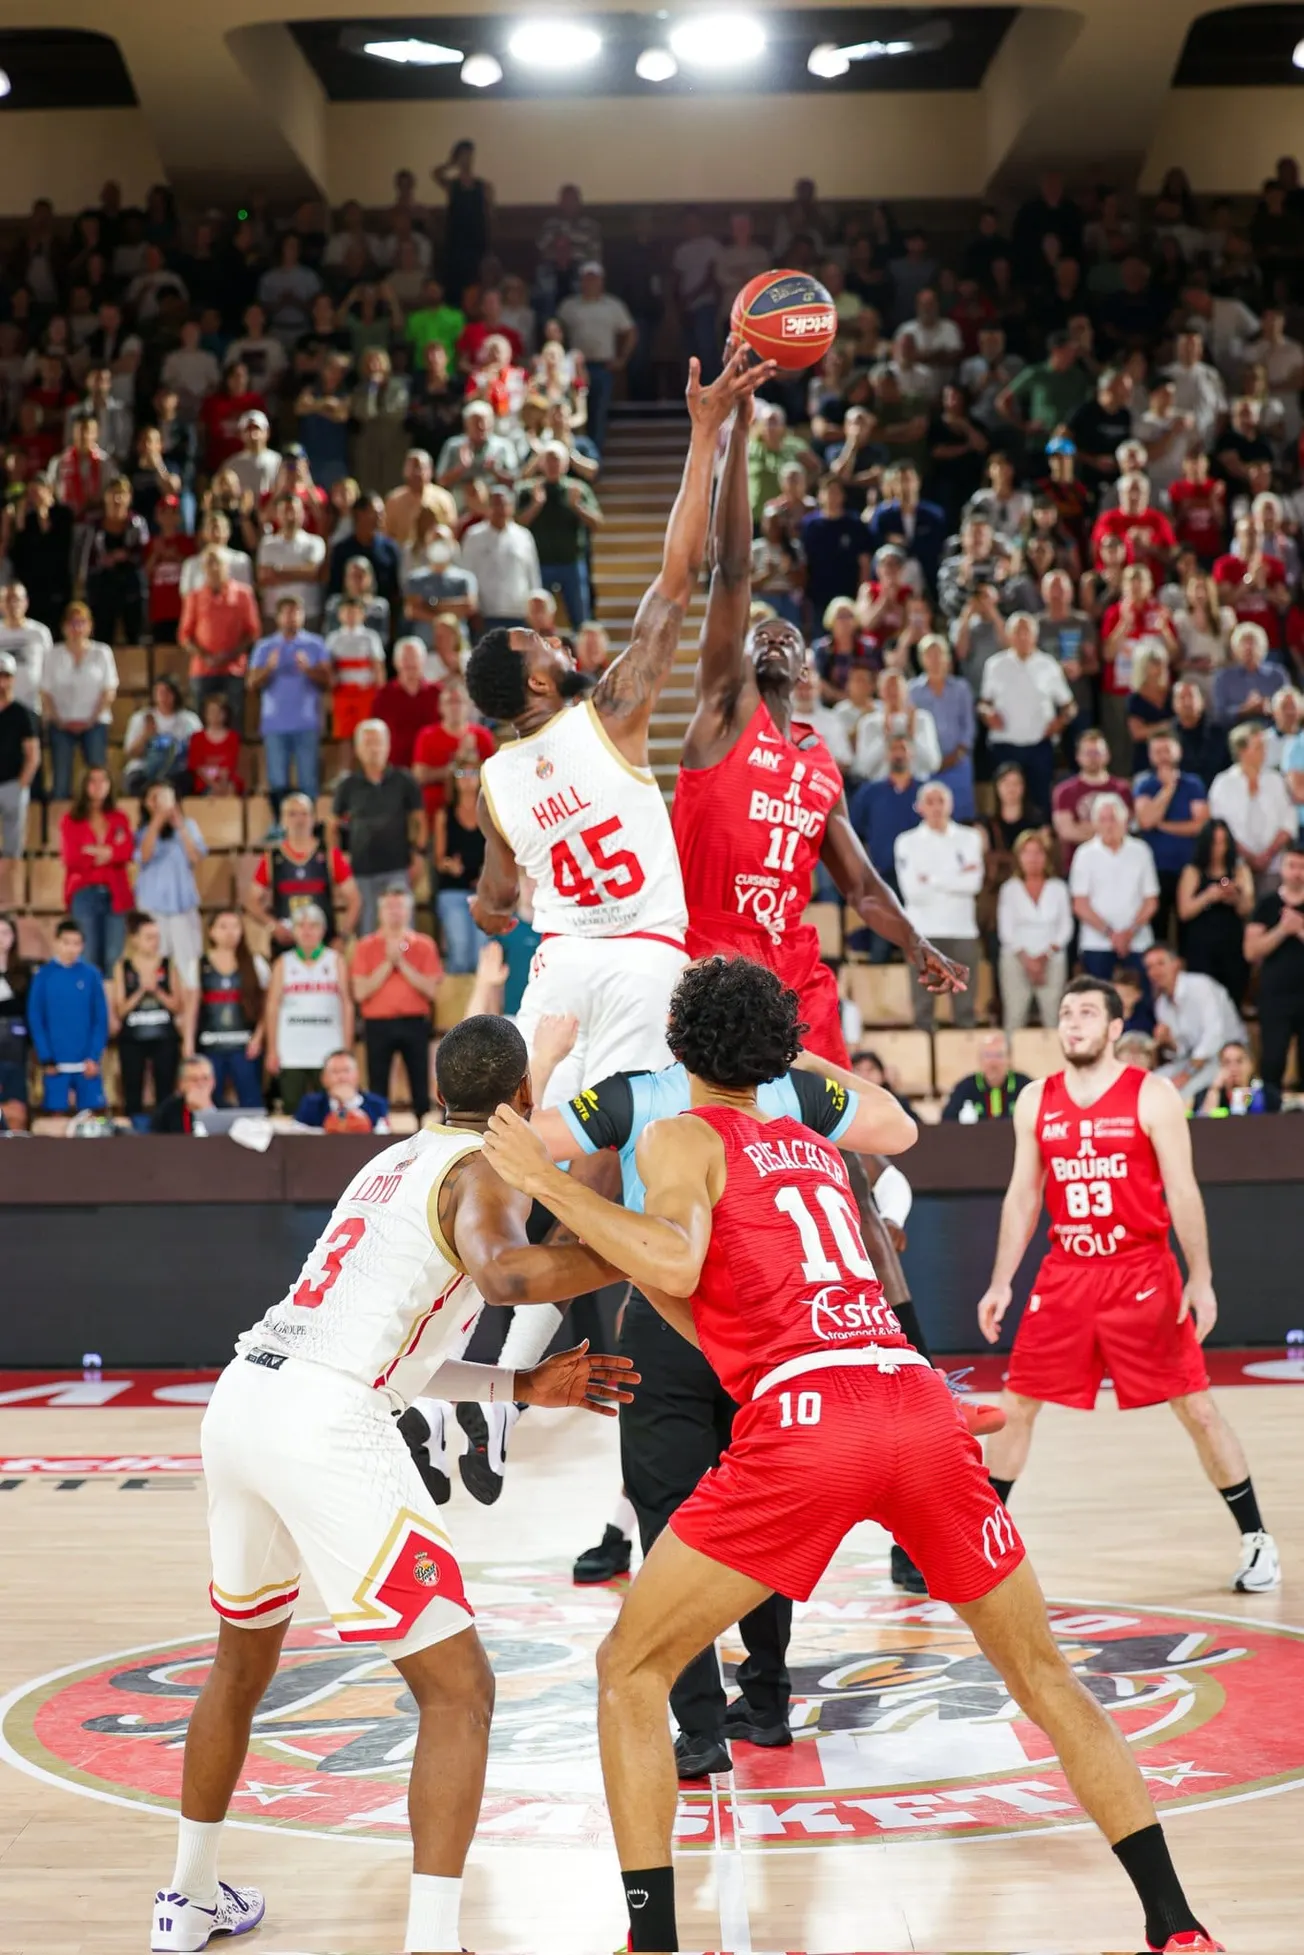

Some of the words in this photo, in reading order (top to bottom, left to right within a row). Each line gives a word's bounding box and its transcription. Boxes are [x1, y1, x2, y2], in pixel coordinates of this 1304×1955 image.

[532, 786, 591, 830] HALL
[749, 789, 825, 838] BOURG
[551, 815, 645, 906] 45
[763, 827, 800, 872] 11
[573, 1096, 590, 1121] OSTE
[743, 1140, 848, 1189] RISACHER
[1051, 1153, 1128, 1182] BOURG
[349, 1174, 402, 1204] LOYD
[1065, 1181, 1113, 1218] 83
[774, 1185, 878, 1283] 10
[1060, 1233, 1117, 1257] YOU
[293, 1217, 366, 1309] 3
[779, 1391, 822, 1428] 10
[345, 1780, 1075, 1838] AKET
